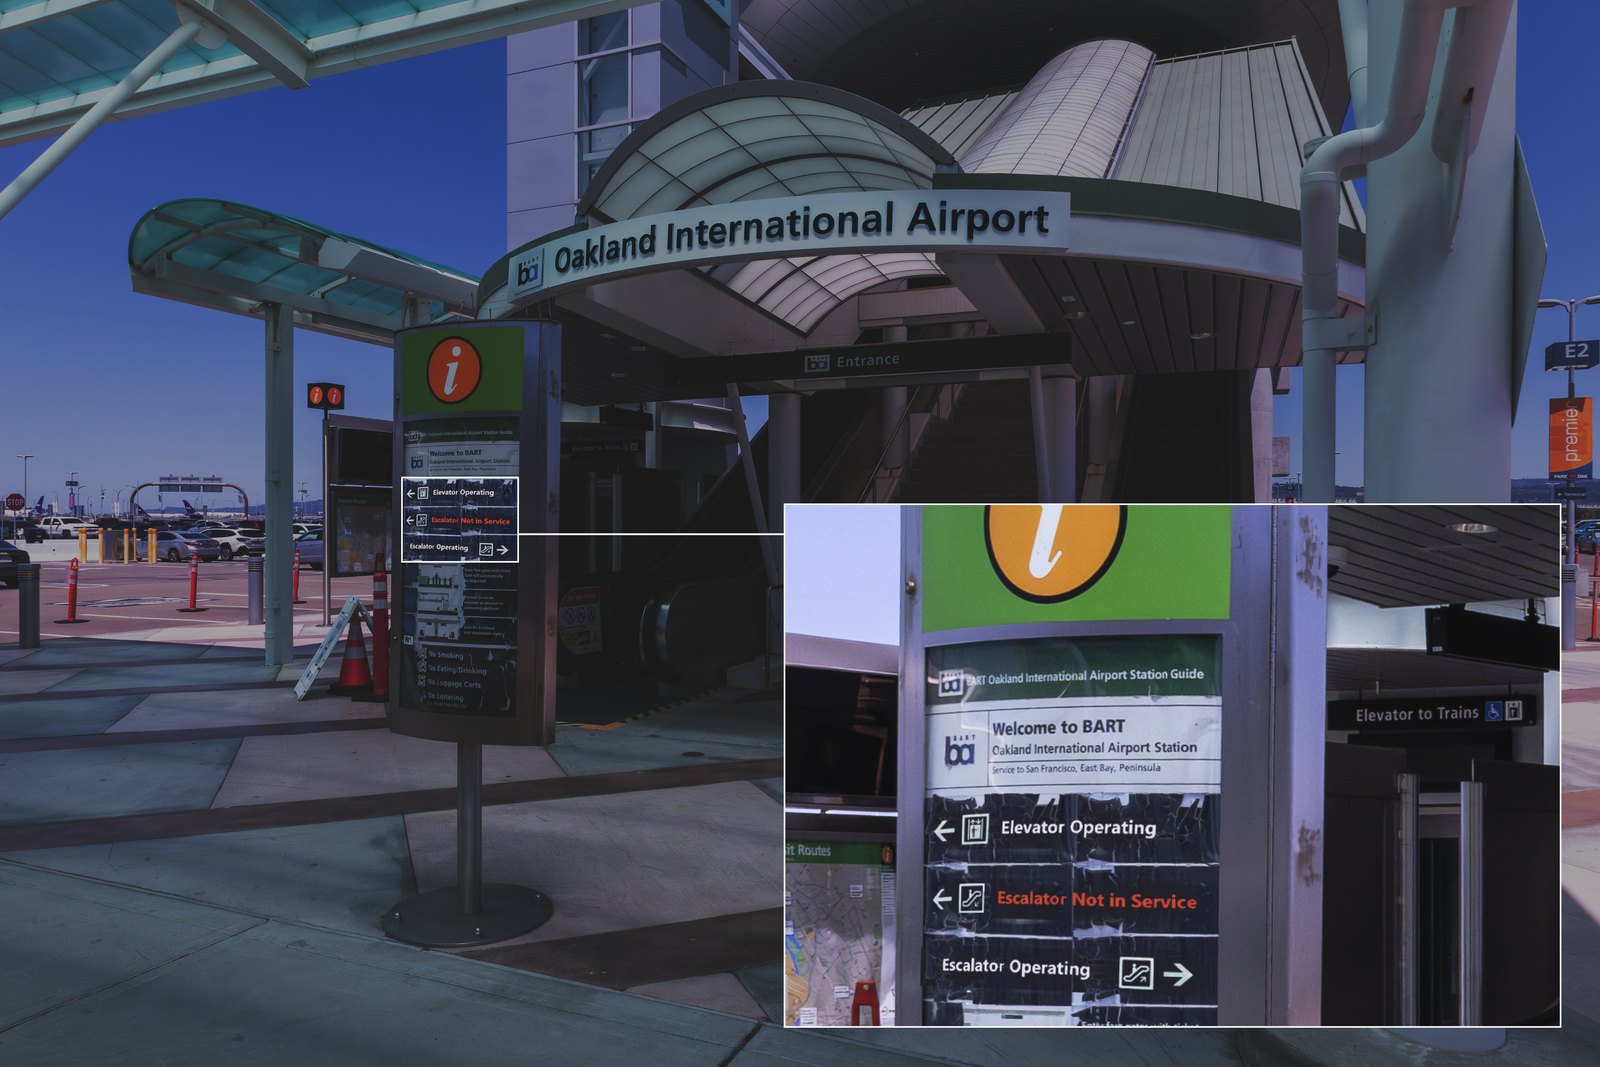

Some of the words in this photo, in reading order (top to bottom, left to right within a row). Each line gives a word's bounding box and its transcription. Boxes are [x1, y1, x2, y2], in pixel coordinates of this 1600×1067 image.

[554, 224, 657, 274] Oakland
[667, 200, 894, 251] International
[907, 200, 1049, 243] Airport
[1565, 343, 1589, 358] E2
[837, 355, 900, 368] Entrance
[460, 489, 495, 497] Operating
[7, 498, 24, 506] STOP
[436, 543, 469, 553] Operating
[437, 651, 464, 661] Smoking
[437, 665, 488, 676] Eating/Drinking
[988, 673, 1024, 686] Oakland
[1025, 670, 1087, 683] International
[1089, 670, 1128, 682] Airport
[1130, 668, 1168, 680] Station
[1170, 668, 1205, 680] Guide
[437, 692, 464, 702] Loitering
[1356, 708, 1414, 722] Elevator
[1418, 708, 1433, 720] to
[1437, 705, 1479, 719] Trains
[992, 721, 1056, 736] Welcome
[1061, 720, 1078, 734] to
[1083, 718, 1126, 733] BART
[992, 743, 1032, 756] Oakland
[1034, 742, 1104, 755] International
[1108, 741, 1151, 755] Airport
[1154, 741, 1198, 753] Station
[992, 766, 1014, 774] Service
[1026, 765, 1039, 773] San
[1041, 764, 1078, 774] Francisco,
[1080, 763, 1098, 772] East
[1099, 763, 1117, 774] Bay,
[1119, 763, 1161, 772] Peninsula
[1001, 820, 1065, 835] Elevator
[1070, 820, 1157, 839] Operating
[798, 844, 832, 857] Routes
[997, 891, 1067, 905] Escalator
[1072, 892, 1105, 907] Not
[1109, 892, 1126, 907] in
[1131, 893, 1197, 909] Service
[942, 957, 1005, 972] Escalator
[1009, 959, 1091, 980] Operating
